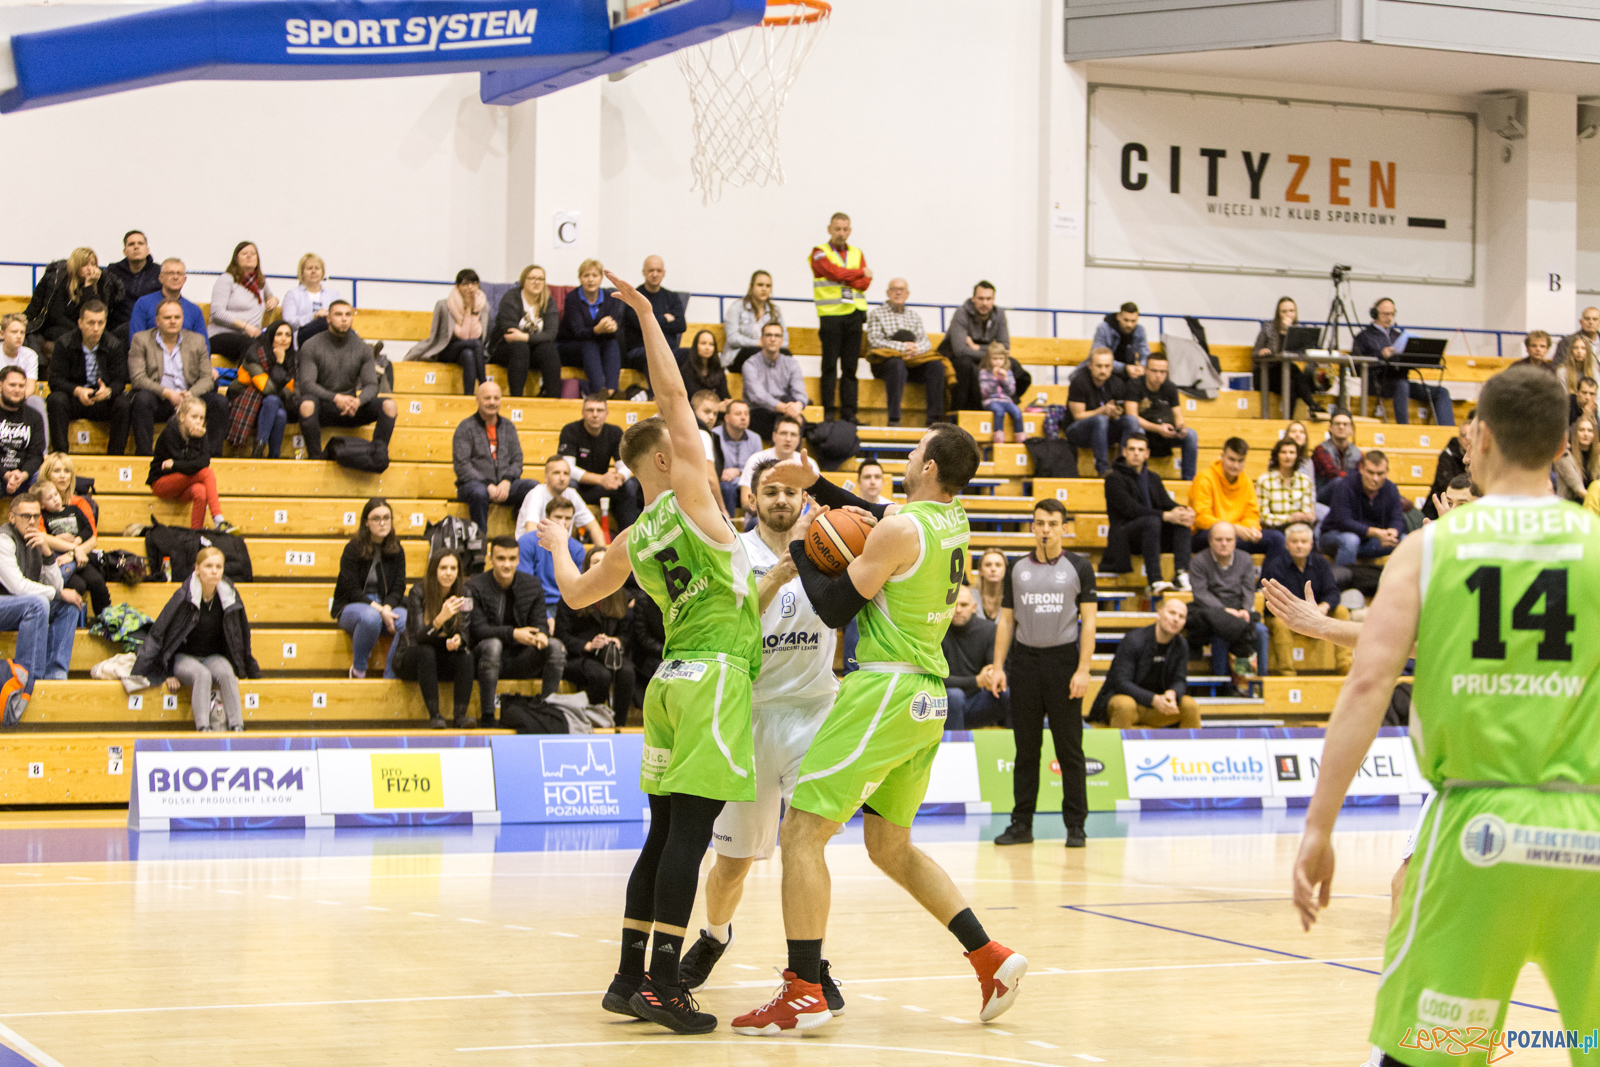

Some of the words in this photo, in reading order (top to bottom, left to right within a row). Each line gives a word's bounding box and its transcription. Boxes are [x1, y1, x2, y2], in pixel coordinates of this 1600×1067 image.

[286, 18, 400, 45] SPORT
[403, 9, 538, 50] SYSTEM
[1120, 142, 1396, 209] CITYZEN
[1288, 208, 1321, 221] KLUB
[1327, 210, 1397, 226] SPORTOWY
[558, 222, 577, 245] C
[1548, 273, 1562, 291] B
[1450, 509, 1592, 535] UNIBEN
[812, 531, 841, 569] molten
[654, 547, 693, 603] 6
[946, 547, 965, 605] 9
[781, 591, 797, 618] 8
[1021, 592, 1064, 605] VERONI
[1035, 604, 1063, 613] active
[1465, 566, 1576, 661] 14
[762, 631, 819, 648] IOFARM
[1452, 671, 1586, 698] PRUSZKÓW
[381, 767, 402, 780] pro
[1170, 756, 1263, 774] funclub
[149, 767, 304, 792] BIOFARM
[162, 797, 195, 805] POLSKI
[200, 796, 256, 804] PRODUCENT
[261, 795, 293, 804] LEKÓW
[544, 782, 619, 804] HOTEL
[546, 804, 620, 816] POZNAŃSKI
[1422, 1001, 1461, 1021] LOGO
